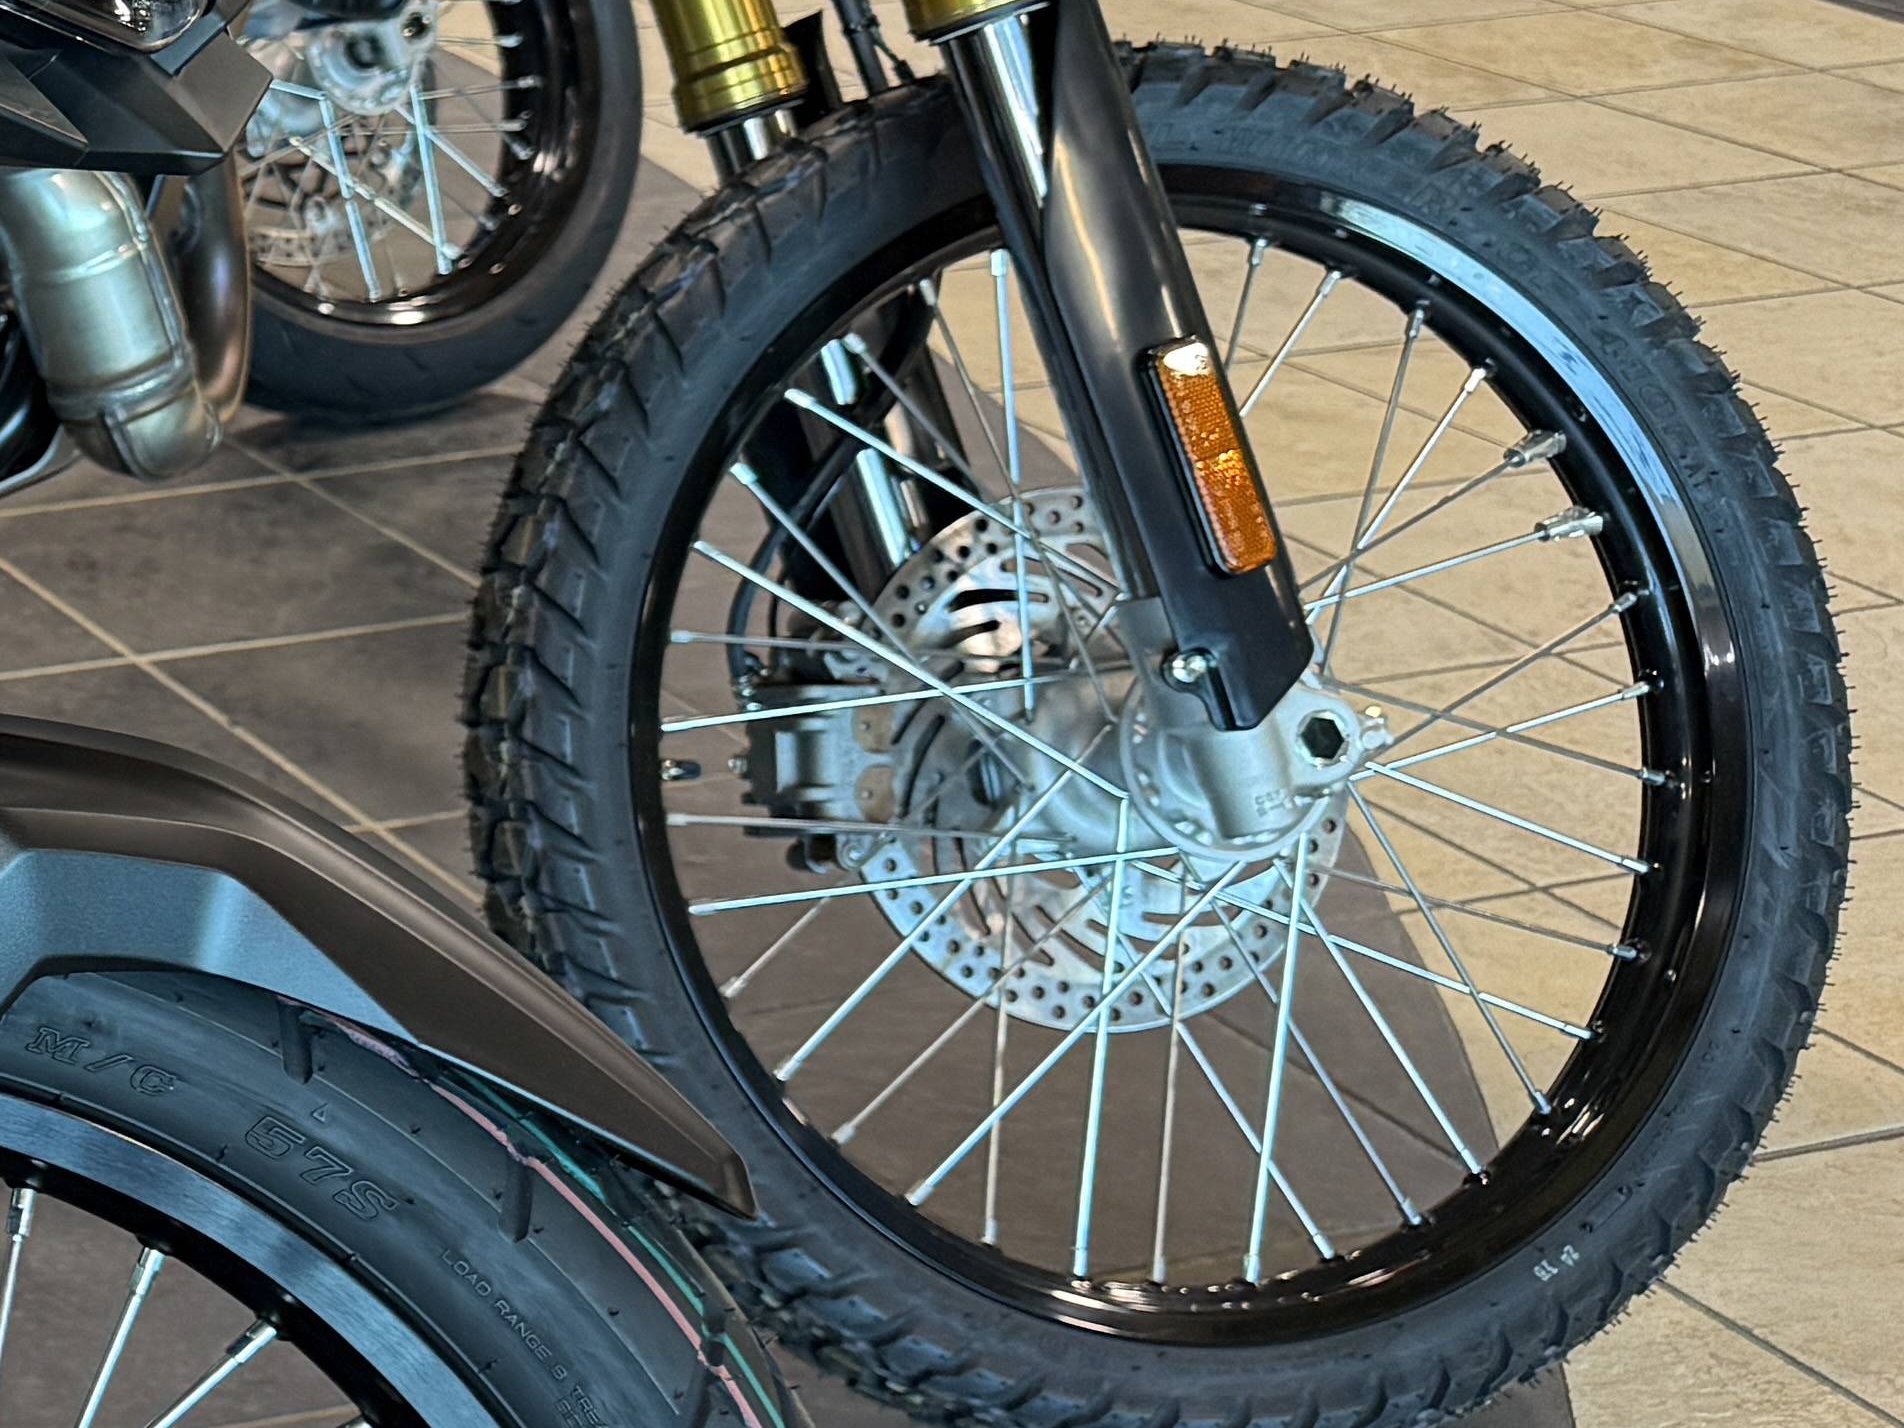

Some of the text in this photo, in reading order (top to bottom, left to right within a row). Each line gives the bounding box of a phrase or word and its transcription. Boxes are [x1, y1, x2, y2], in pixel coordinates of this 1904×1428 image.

[26, 1024, 179, 1098] M/C
[244, 1113, 399, 1222] 57S
[440, 1248, 492, 1298] LOAD
[494, 1298, 552, 1361] RANGE
